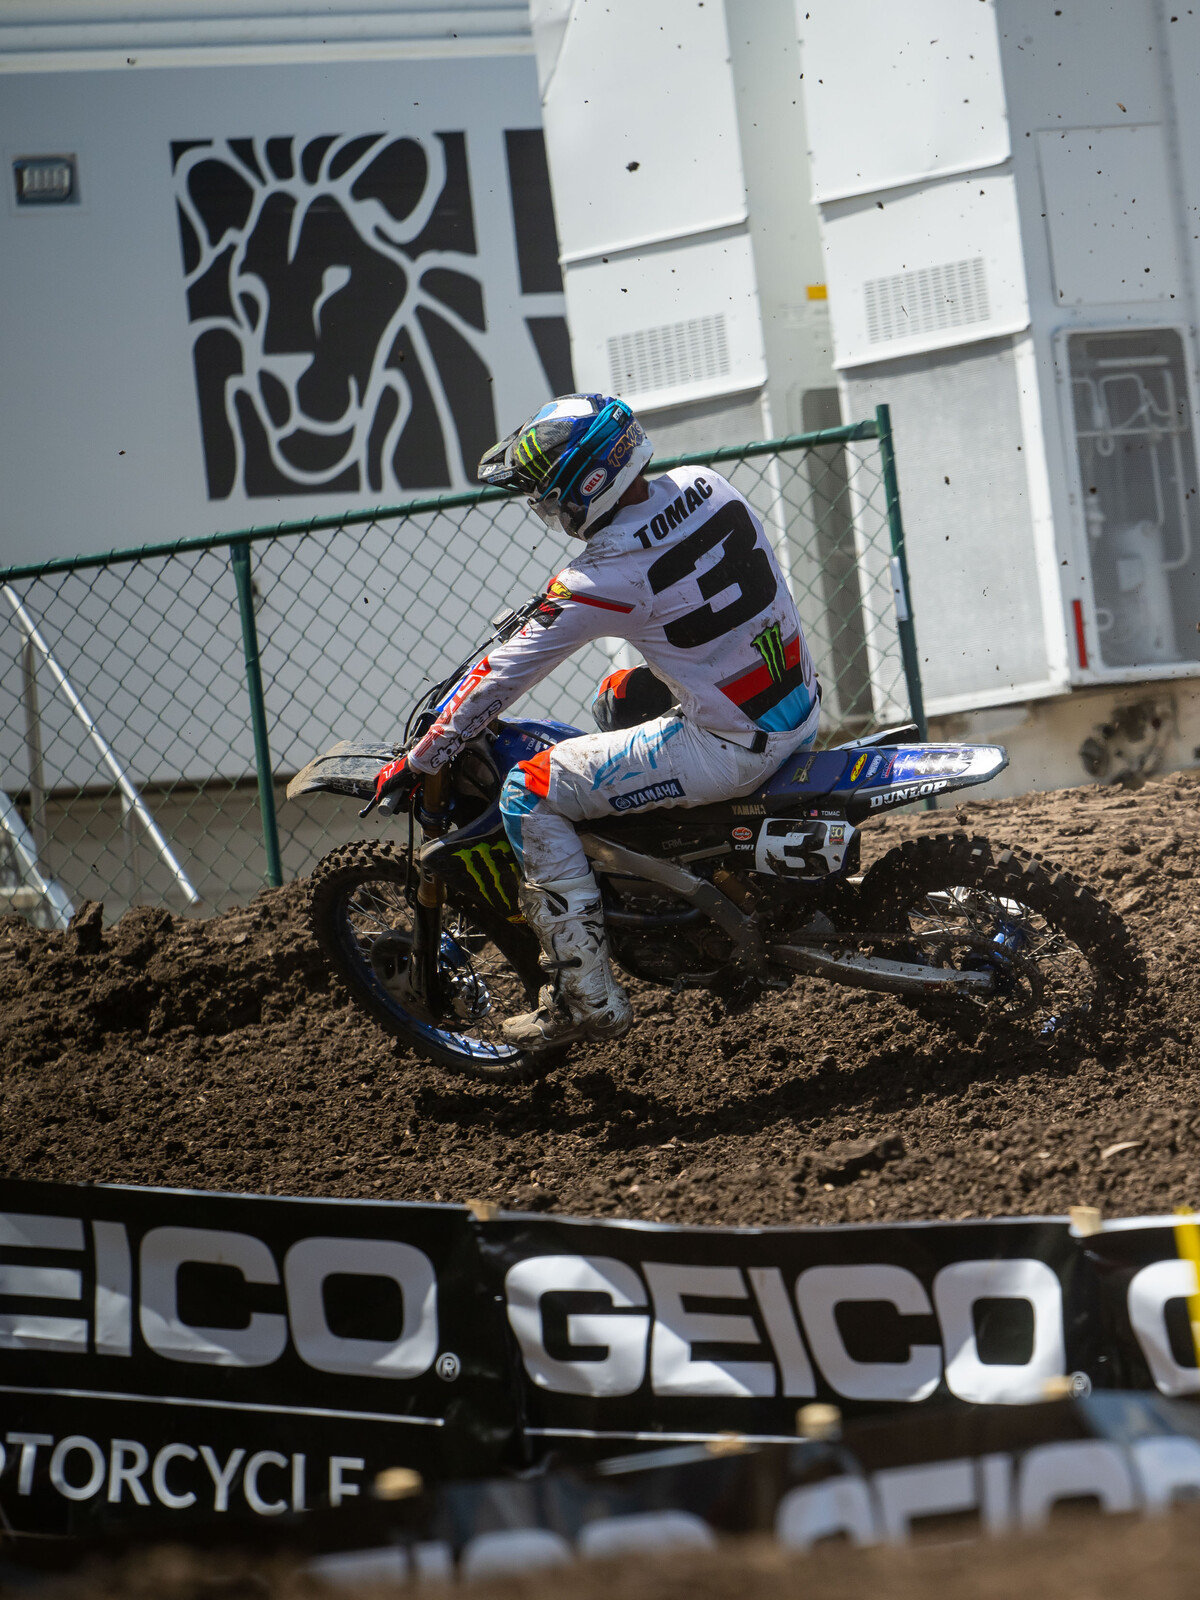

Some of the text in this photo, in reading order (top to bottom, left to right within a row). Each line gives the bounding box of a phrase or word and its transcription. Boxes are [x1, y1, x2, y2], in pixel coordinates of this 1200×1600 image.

[584, 472, 605, 493] BELL
[633, 476, 713, 549] TOMAC
[647, 500, 777, 649] 3
[526, 730, 542, 751] TOMC
[629, 782, 680, 803] YAMAHA
[731, 804, 767, 815] YAMAHA
[870, 780, 948, 808] DUNLOP
[765, 820, 830, 878] 3
[504, 1253, 1067, 1405] GEICO
[0, 1432, 365, 1516] TORCYCLE
